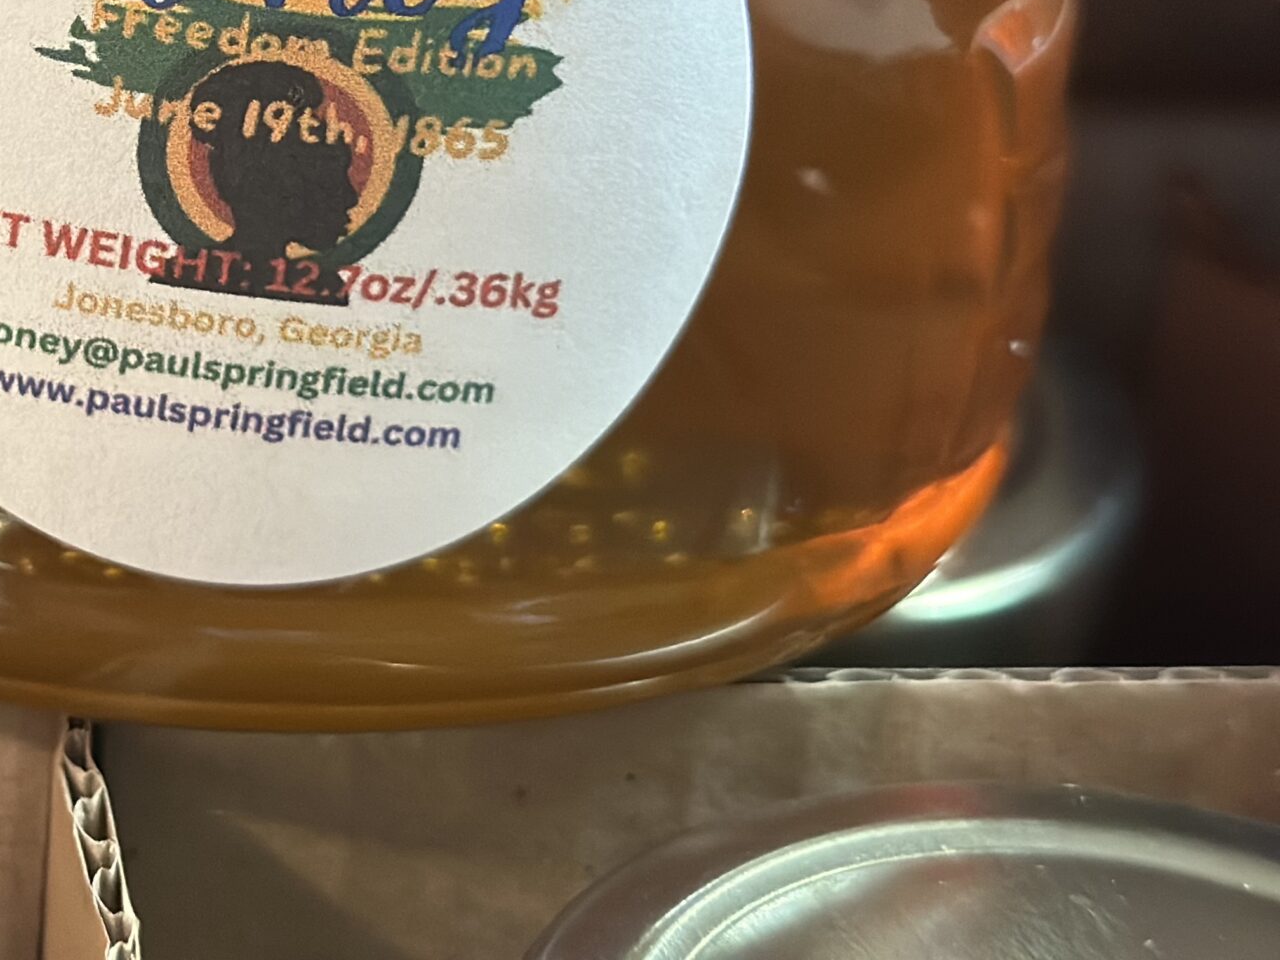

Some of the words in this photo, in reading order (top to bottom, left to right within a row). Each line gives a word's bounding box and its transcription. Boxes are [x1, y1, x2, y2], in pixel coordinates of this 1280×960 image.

[352, 27, 538, 81] Edition
[94, 76, 222, 132] June
[242, 99, 369, 149] 19th,
[388, 115, 509, 160] 1865
[42, 220, 253, 287] WEIGHT:
[51, 280, 266, 345] Jonesboro,
[278, 314, 424, 359] Georgia
